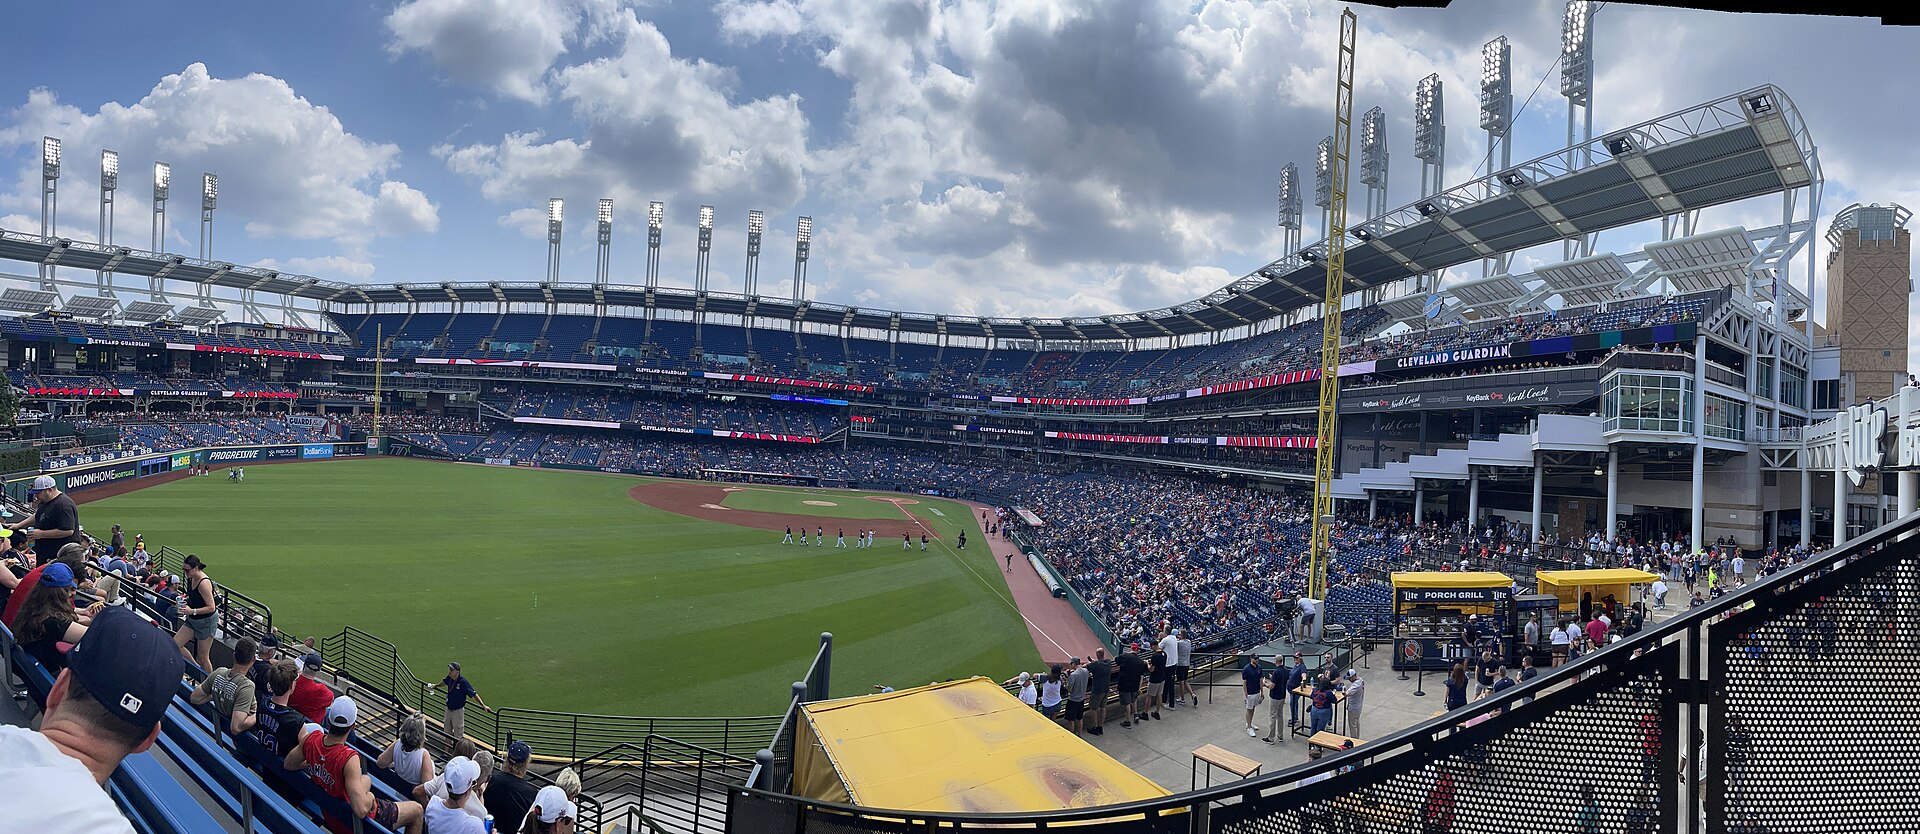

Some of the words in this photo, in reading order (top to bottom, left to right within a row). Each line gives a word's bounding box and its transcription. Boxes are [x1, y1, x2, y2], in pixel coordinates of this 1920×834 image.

[1397, 352, 1448, 368] CLEVELAND
[1453, 343, 1512, 361] GUARDIAN
[1466, 394, 1489, 402] KeyBank
[290, 417, 312, 425] GUARDS
[1347, 444, 1374, 452] KeyBan
[209, 450, 260, 460] PROGRESSIVE
[76, 457, 92, 465] Elk-Elk
[172, 456, 190, 467] bet365
[1404, 592, 1418, 600] Lite
[1493, 591, 1506, 600] Lite
